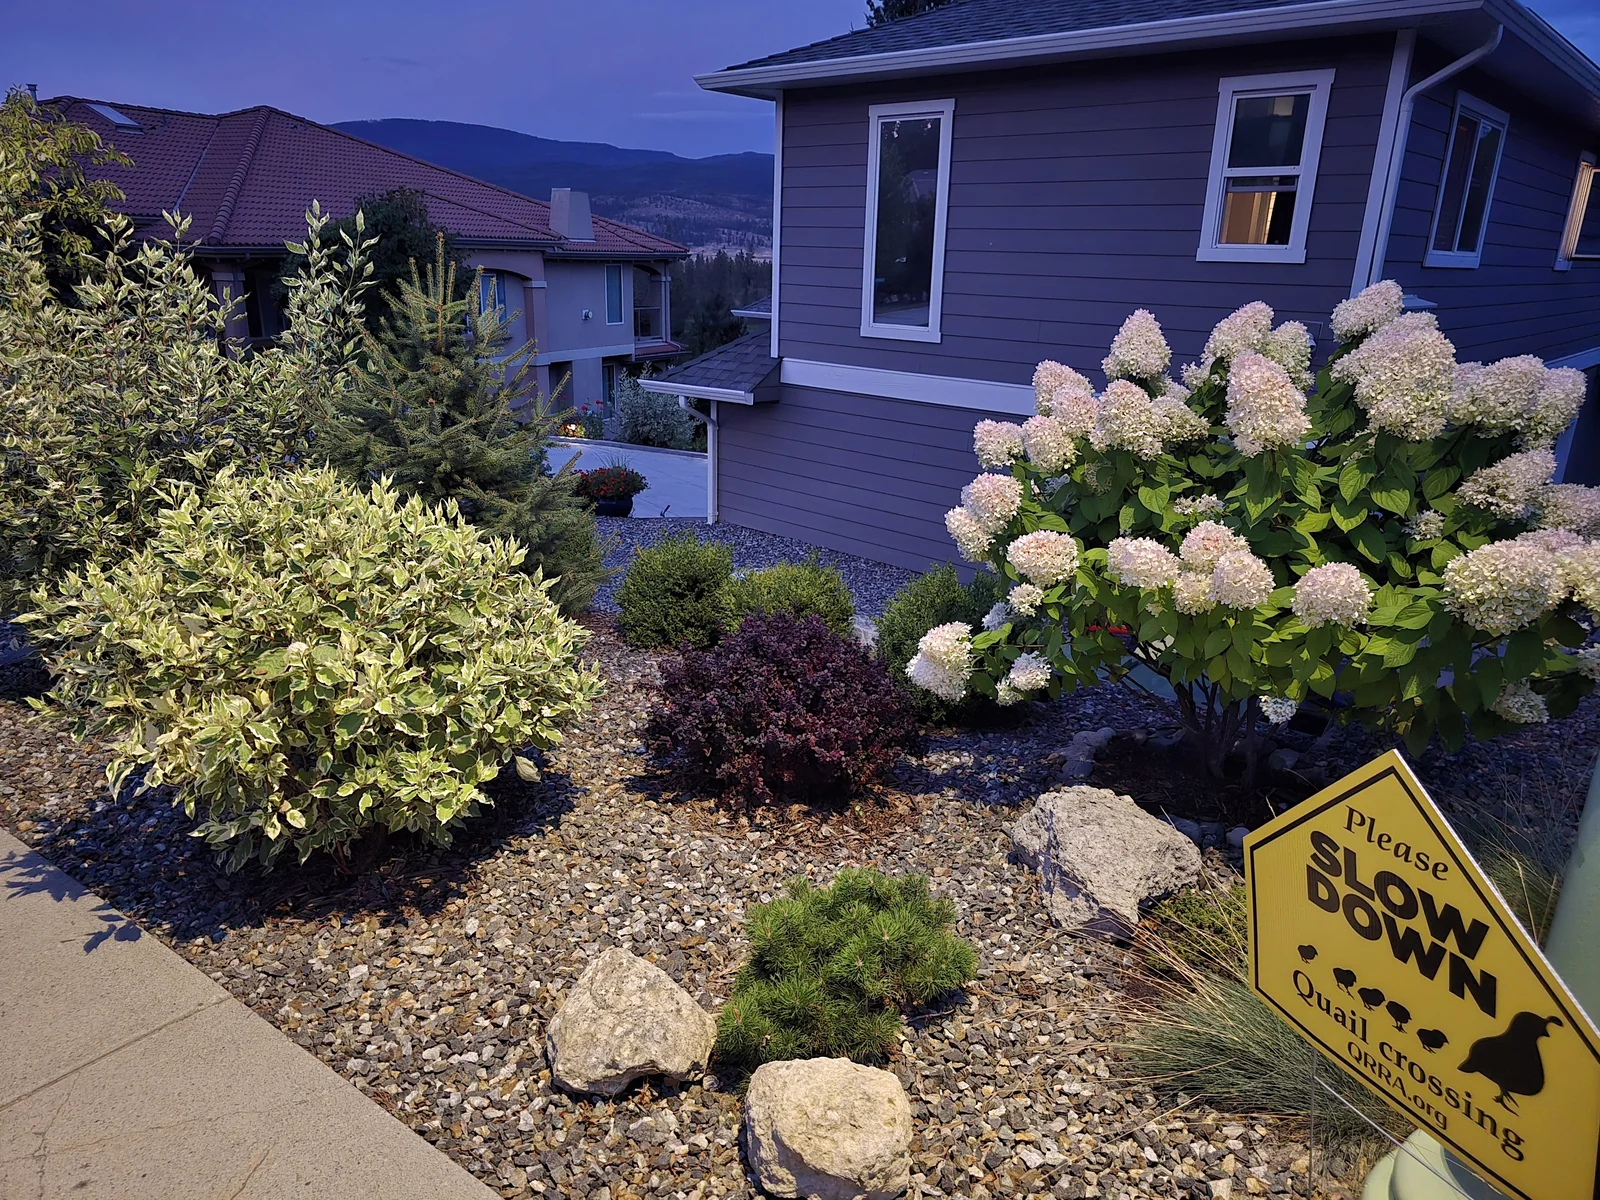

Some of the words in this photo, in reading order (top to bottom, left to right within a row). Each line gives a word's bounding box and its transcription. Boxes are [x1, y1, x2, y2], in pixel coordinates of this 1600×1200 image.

[1310, 830, 1490, 961] SLOW
[1343, 804, 1449, 882] Please
[1306, 864, 1498, 1019] DOWN
[1292, 969, 1368, 1046] Quail
[1379, 1041, 1526, 1162] crossing
[1347, 1042, 1448, 1131] QRRA.org
